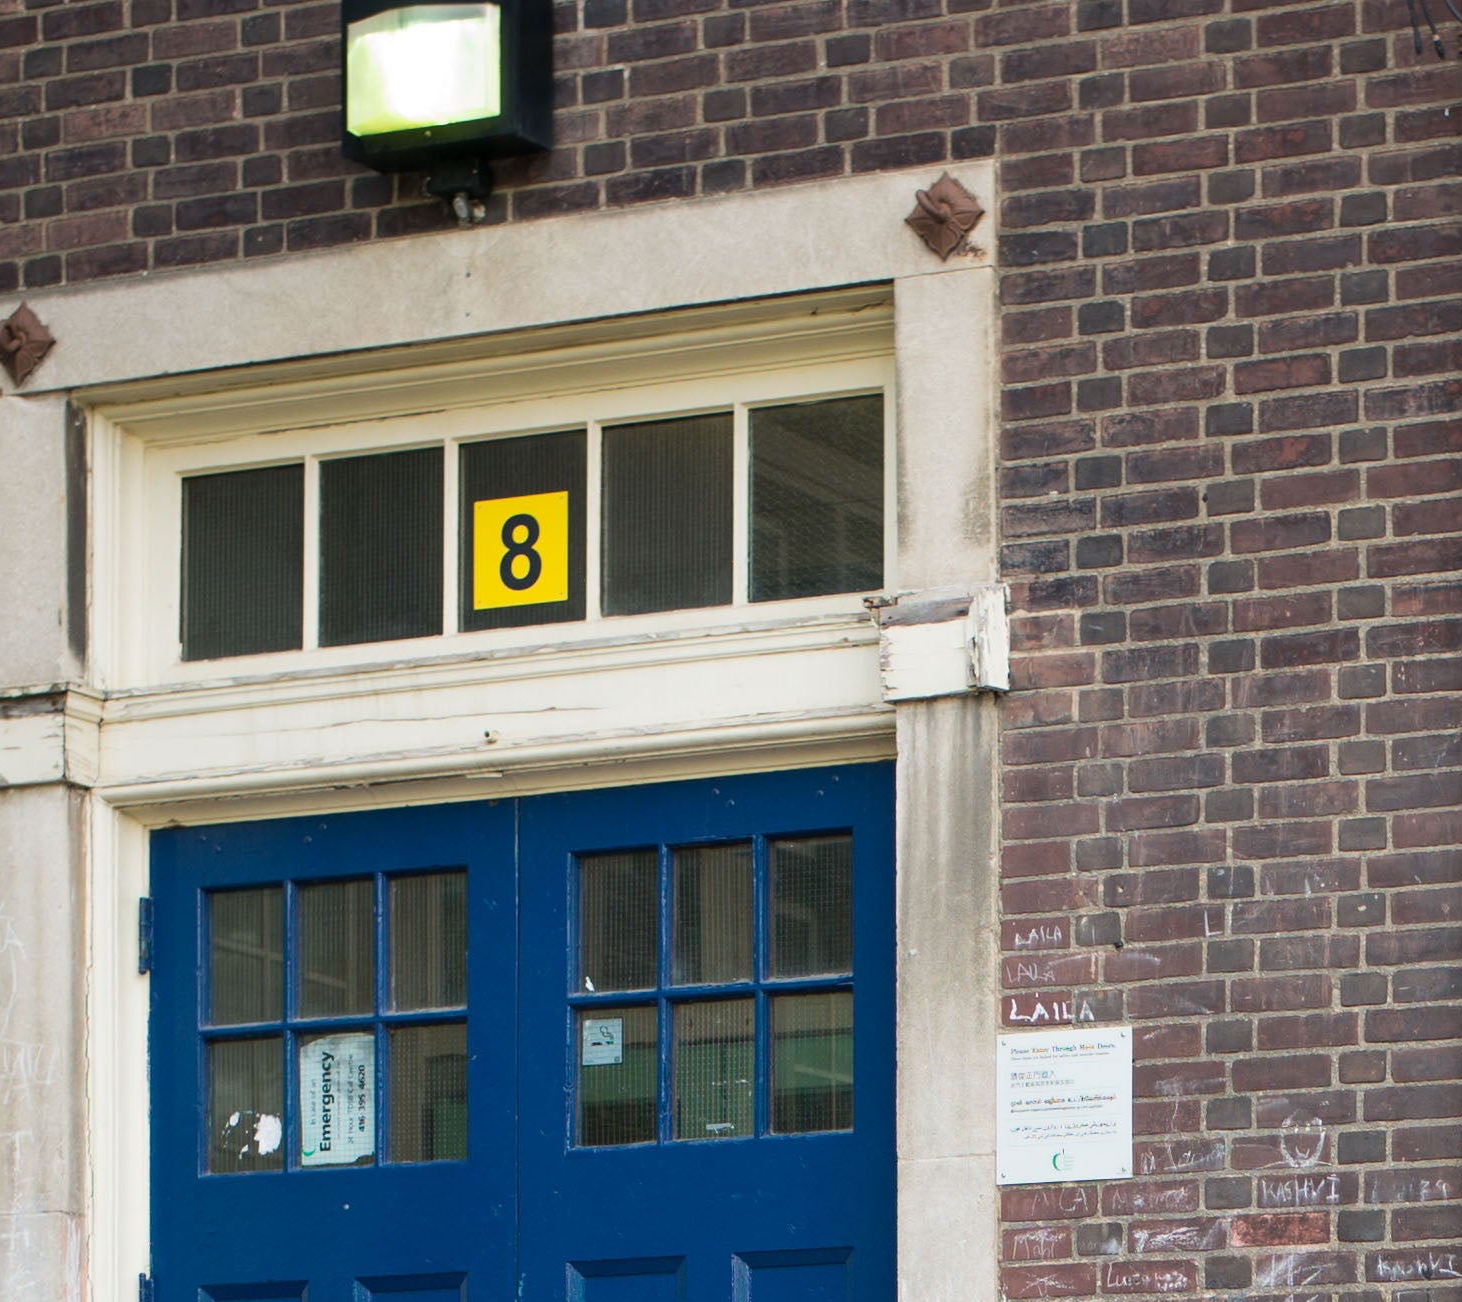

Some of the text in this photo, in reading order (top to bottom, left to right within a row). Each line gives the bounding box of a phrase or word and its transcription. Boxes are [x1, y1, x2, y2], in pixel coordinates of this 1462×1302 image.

[499, 513, 542, 591] 8
[1009, 998, 1095, 1023] LAILA
[320, 1051, 334, 1152] Emergency
